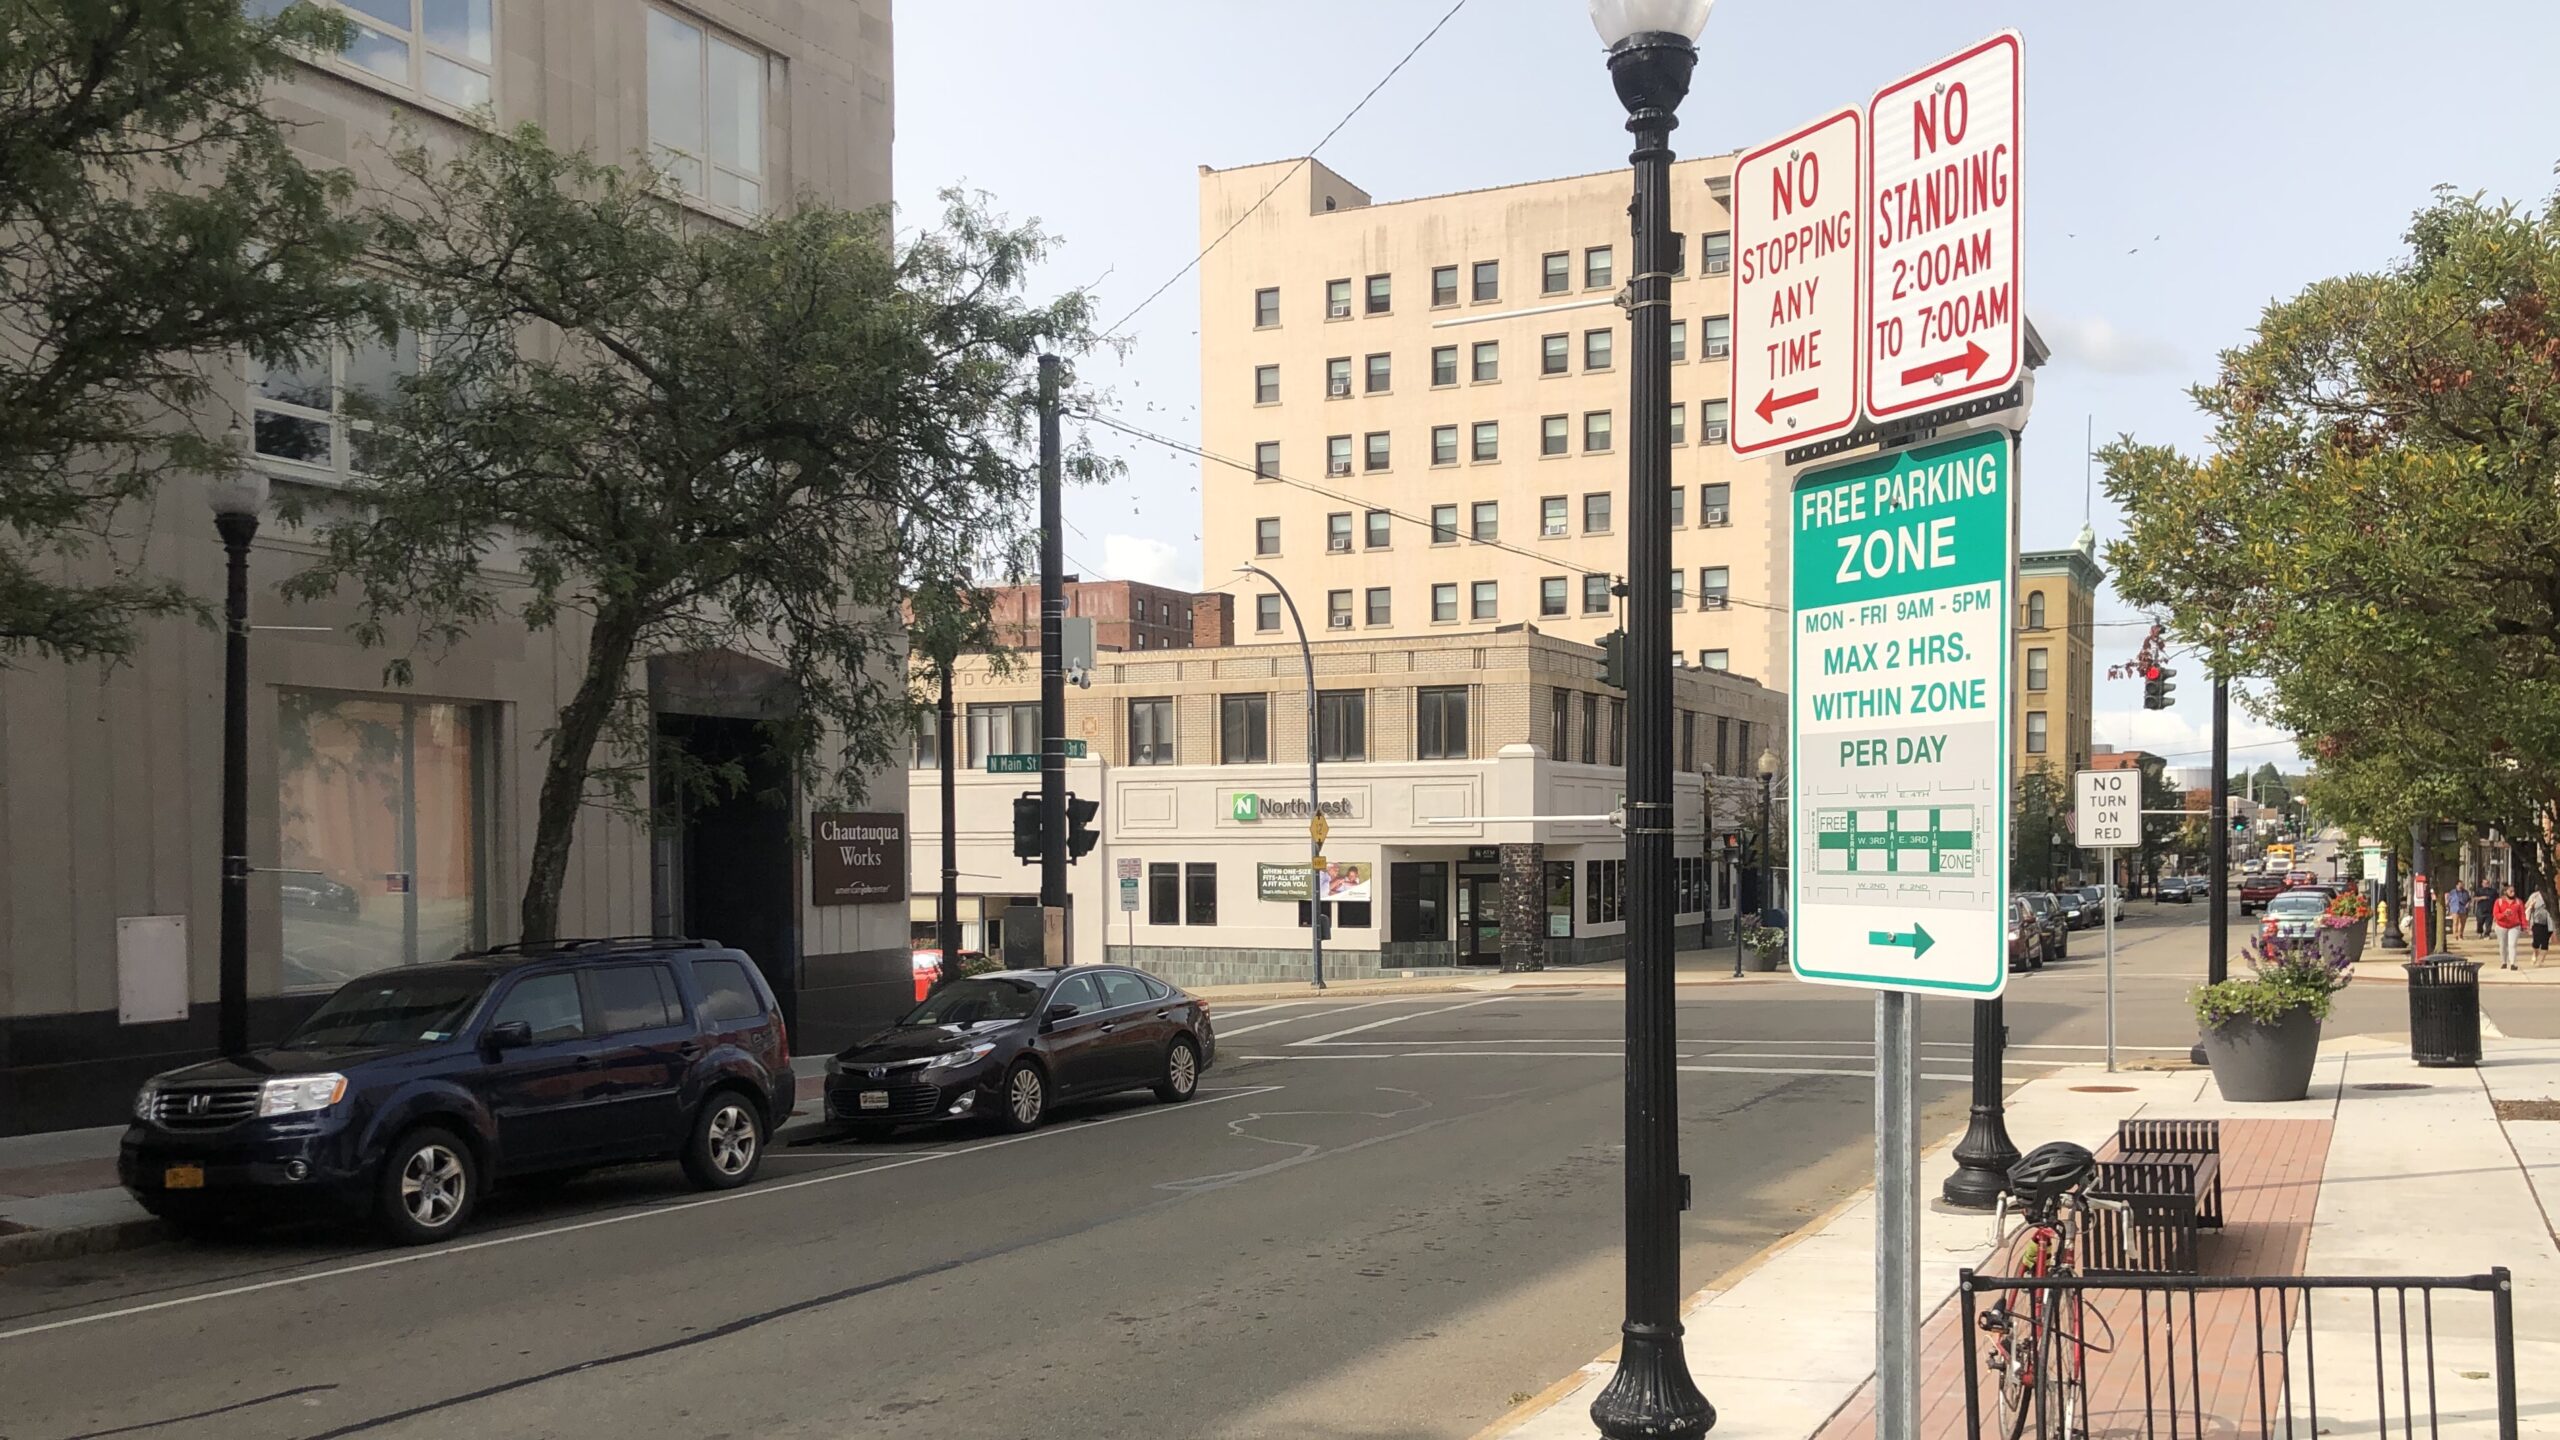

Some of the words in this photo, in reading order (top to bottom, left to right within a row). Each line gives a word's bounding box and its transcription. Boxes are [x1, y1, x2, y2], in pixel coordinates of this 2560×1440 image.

[1913, 81, 1968, 160] NO
[1772, 151, 1819, 221] NO
[1878, 143, 2008, 249] STANDING
[1741, 210, 1851, 285] STOPPING
[1891, 229, 1992, 301] 2:00AM
[1770, 276, 1820, 328] ANY
[1876, 316, 1902, 360] TO
[1918, 282, 2009, 349] 7:00AM
[1767, 329, 1822, 380] TIME
[1802, 481, 1866, 531] FREE
[1875, 453, 1997, 517] PARKING
[1836, 516, 1956, 584] ZONE
[1806, 611, 1844, 633] MON
[1860, 604, 1887, 626] FRI
[1896, 597, 1934, 621] 9AM
[1952, 588, 1991, 613] 5PM
[1823, 642, 1878, 676] MAX
[1886, 640, 1900, 669] 2
[1908, 632, 1971, 666] HRS.
[1812, 686, 1901, 721] WITHIN
[1910, 679, 1986, 714] ZONE
[991, 757, 997, 771] N
[1001, 756, 1022, 771] Main
[1027, 756, 1037, 771] St
[1068, 742, 1077, 756] 3rd
[1840, 738, 1888, 767] PER
[1896, 735, 1947, 765] DAY
[2090, 795, 2127, 807] TURN
[2094, 776, 2122, 791] NO
[820, 820, 899, 846] Chautauqua
[1820, 816, 1847, 830] FREE
[2095, 827, 2122, 839] RED
[2098, 811, 2118, 823] ON
[839, 846, 882, 866] Works
[1869, 837, 1886, 845] 3RD
[1909, 835, 1929, 844] 3RD
[1940, 854, 1972, 869] ZONE
